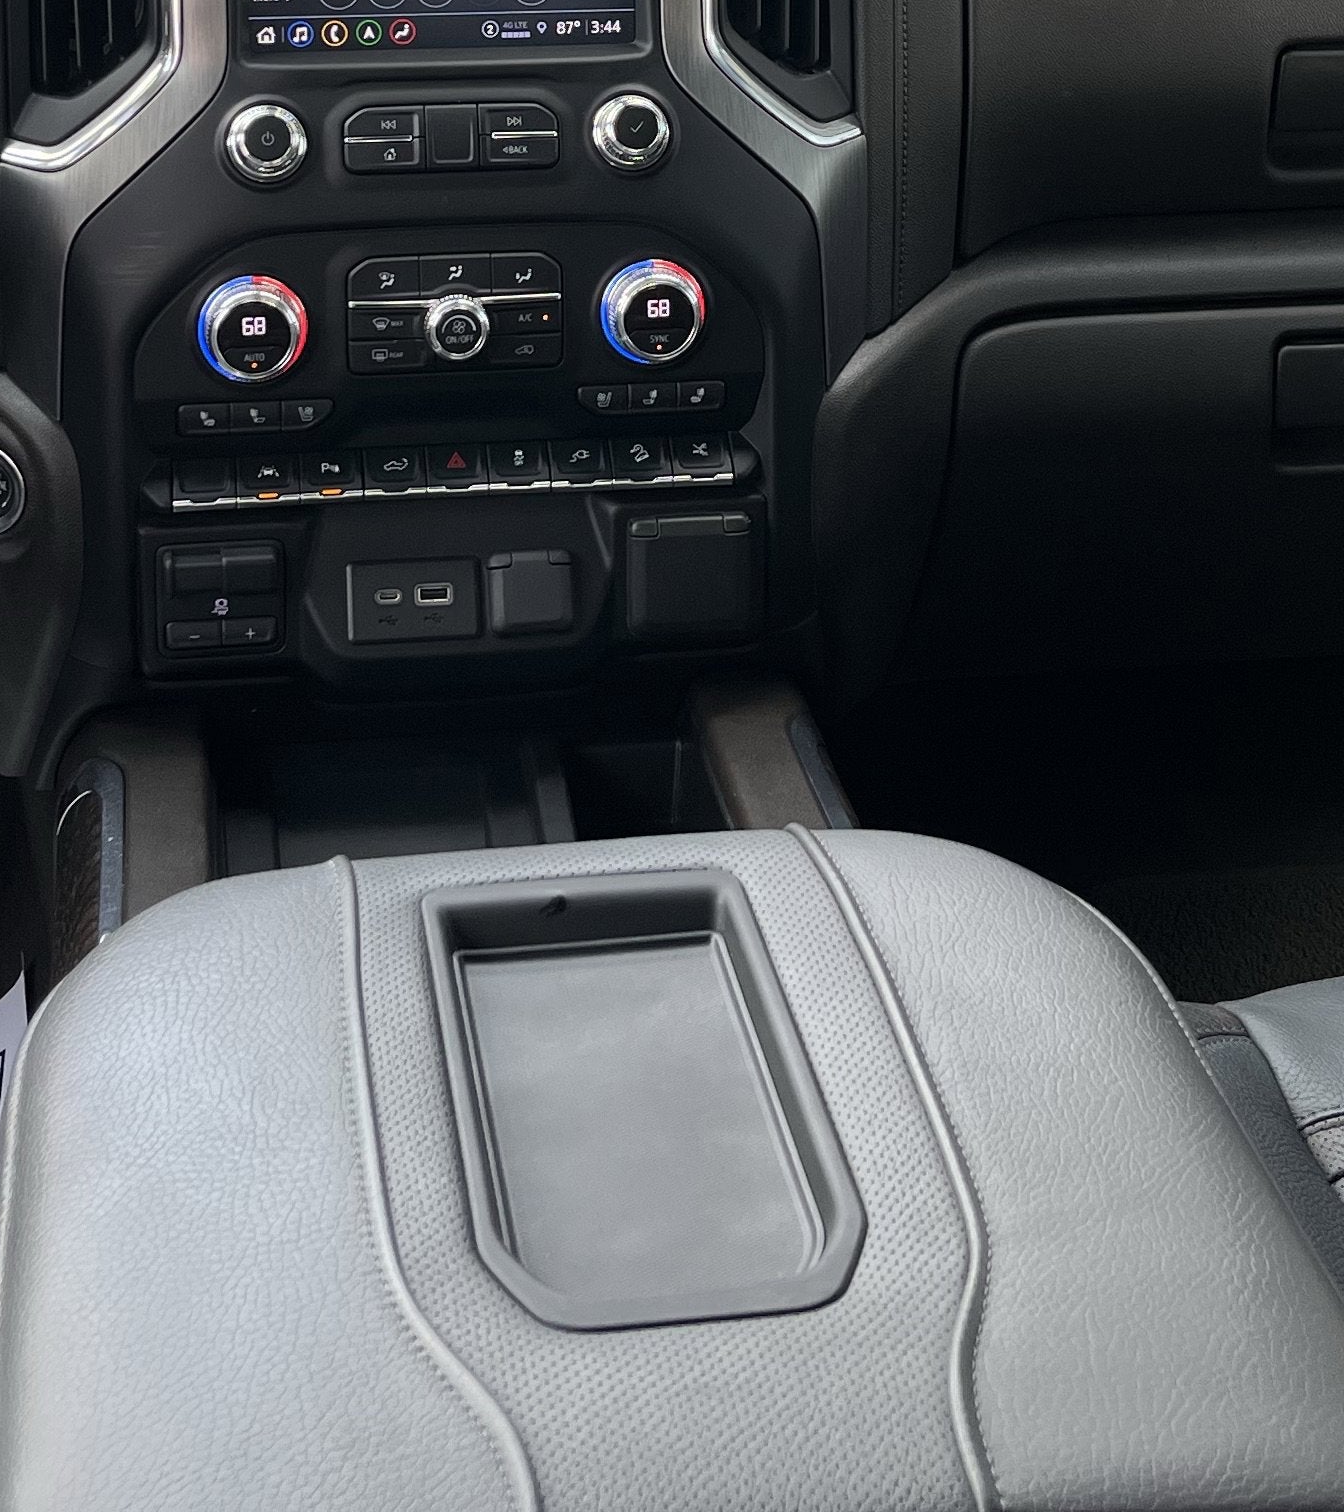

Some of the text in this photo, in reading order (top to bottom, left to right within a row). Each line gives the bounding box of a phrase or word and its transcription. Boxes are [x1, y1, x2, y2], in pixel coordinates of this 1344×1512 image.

[515, 21, 528, 29] LTE
[590, 20, 622, 34] 3:44
[508, 144, 528, 155] BACK
[647, 299, 670, 318] 68
[518, 313, 532, 322] A/C
[242, 317, 266, 336] 68
[445, 335, 474, 344] ON/OFF
[649, 334, 670, 343] SYNC
[244, 352, 265, 362] AUTO
